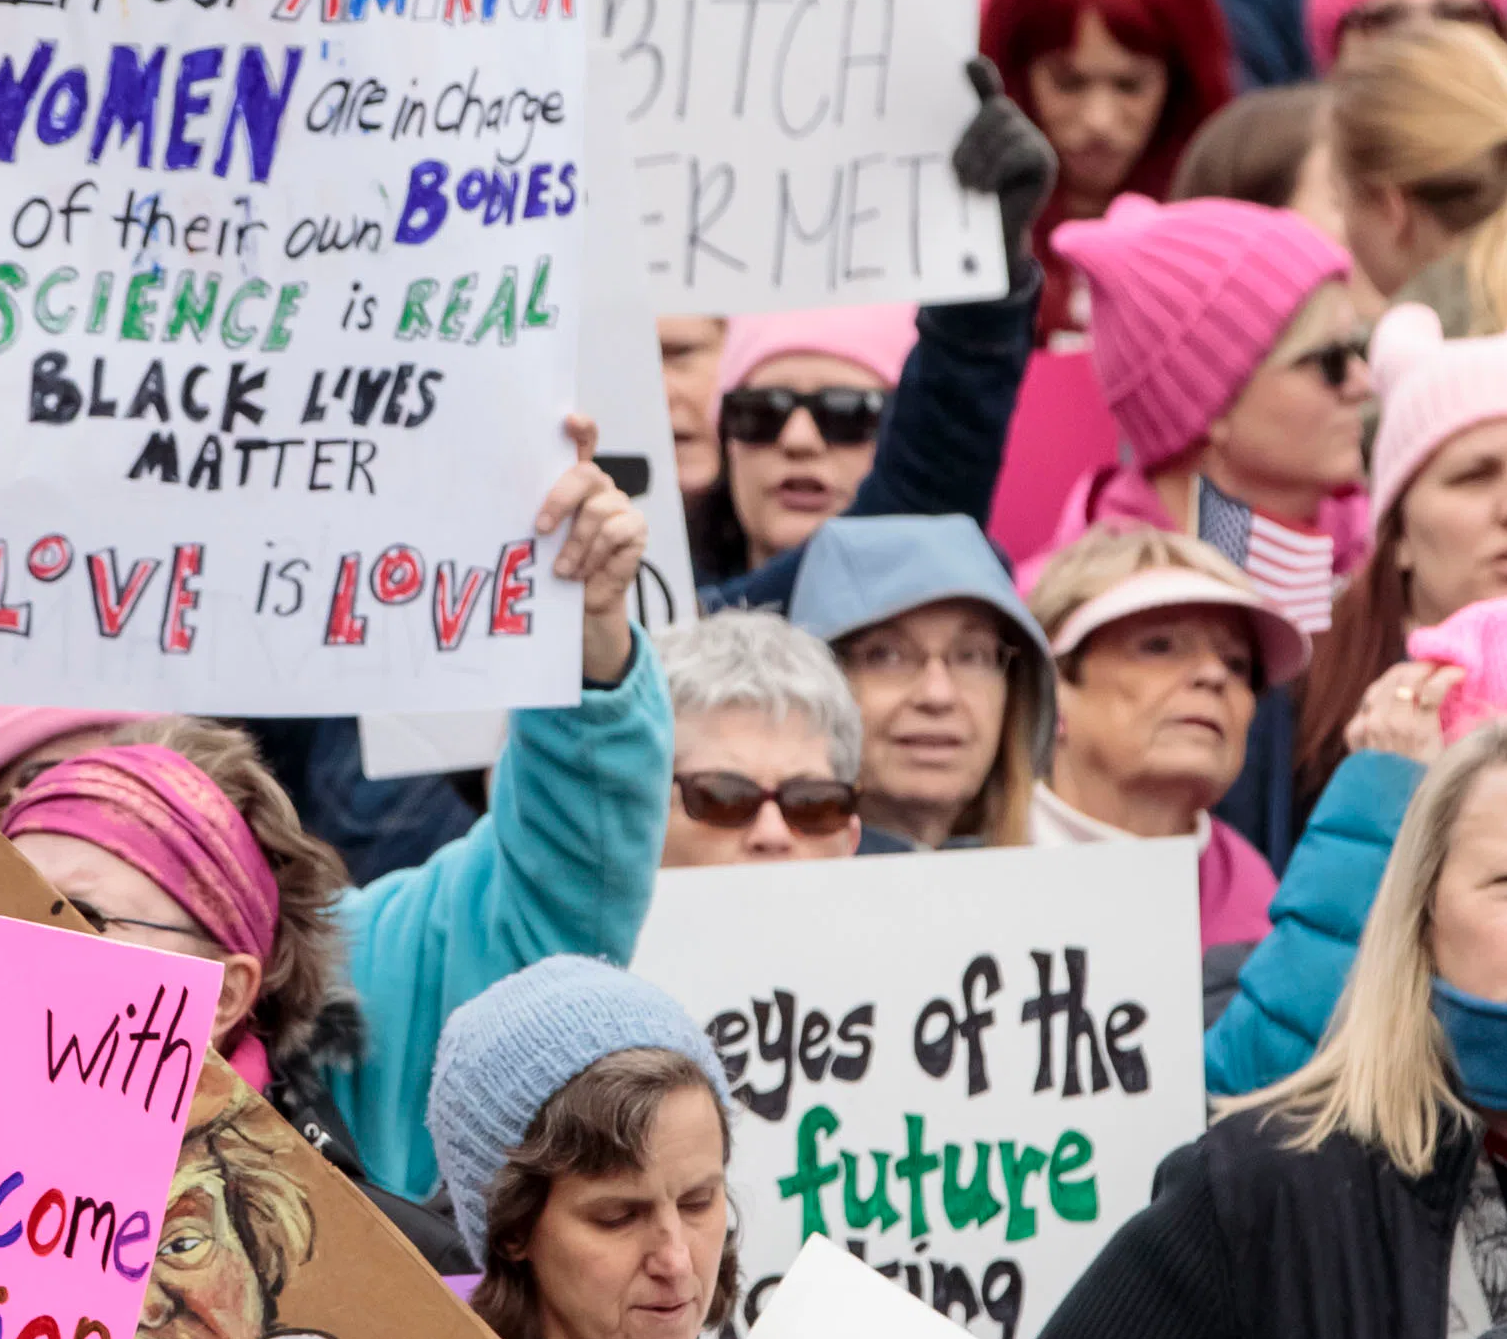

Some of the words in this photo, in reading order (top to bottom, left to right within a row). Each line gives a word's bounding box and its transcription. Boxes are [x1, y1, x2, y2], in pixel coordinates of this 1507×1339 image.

[304, 73, 388, 139] are
[390, 79, 426, 142] in
[10, 178, 100, 250] of
[110, 186, 270, 255] their
[282, 214, 384, 260] own
[340, 281, 379, 332] is
[393, 252, 560, 347] REAL
[27, 348, 271, 435] BLACK
[299, 362, 446, 430] LIVES
[126, 431, 379, 495] MATTER
[254, 539, 312, 617] is
[322, 536, 537, 652] LOVE
[43, 981, 195, 1125] with
[707, 987, 878, 1124] eyes
[912, 951, 1006, 1098] of
[1022, 945, 1152, 1100] the
[777, 1103, 1102, 1245] future
